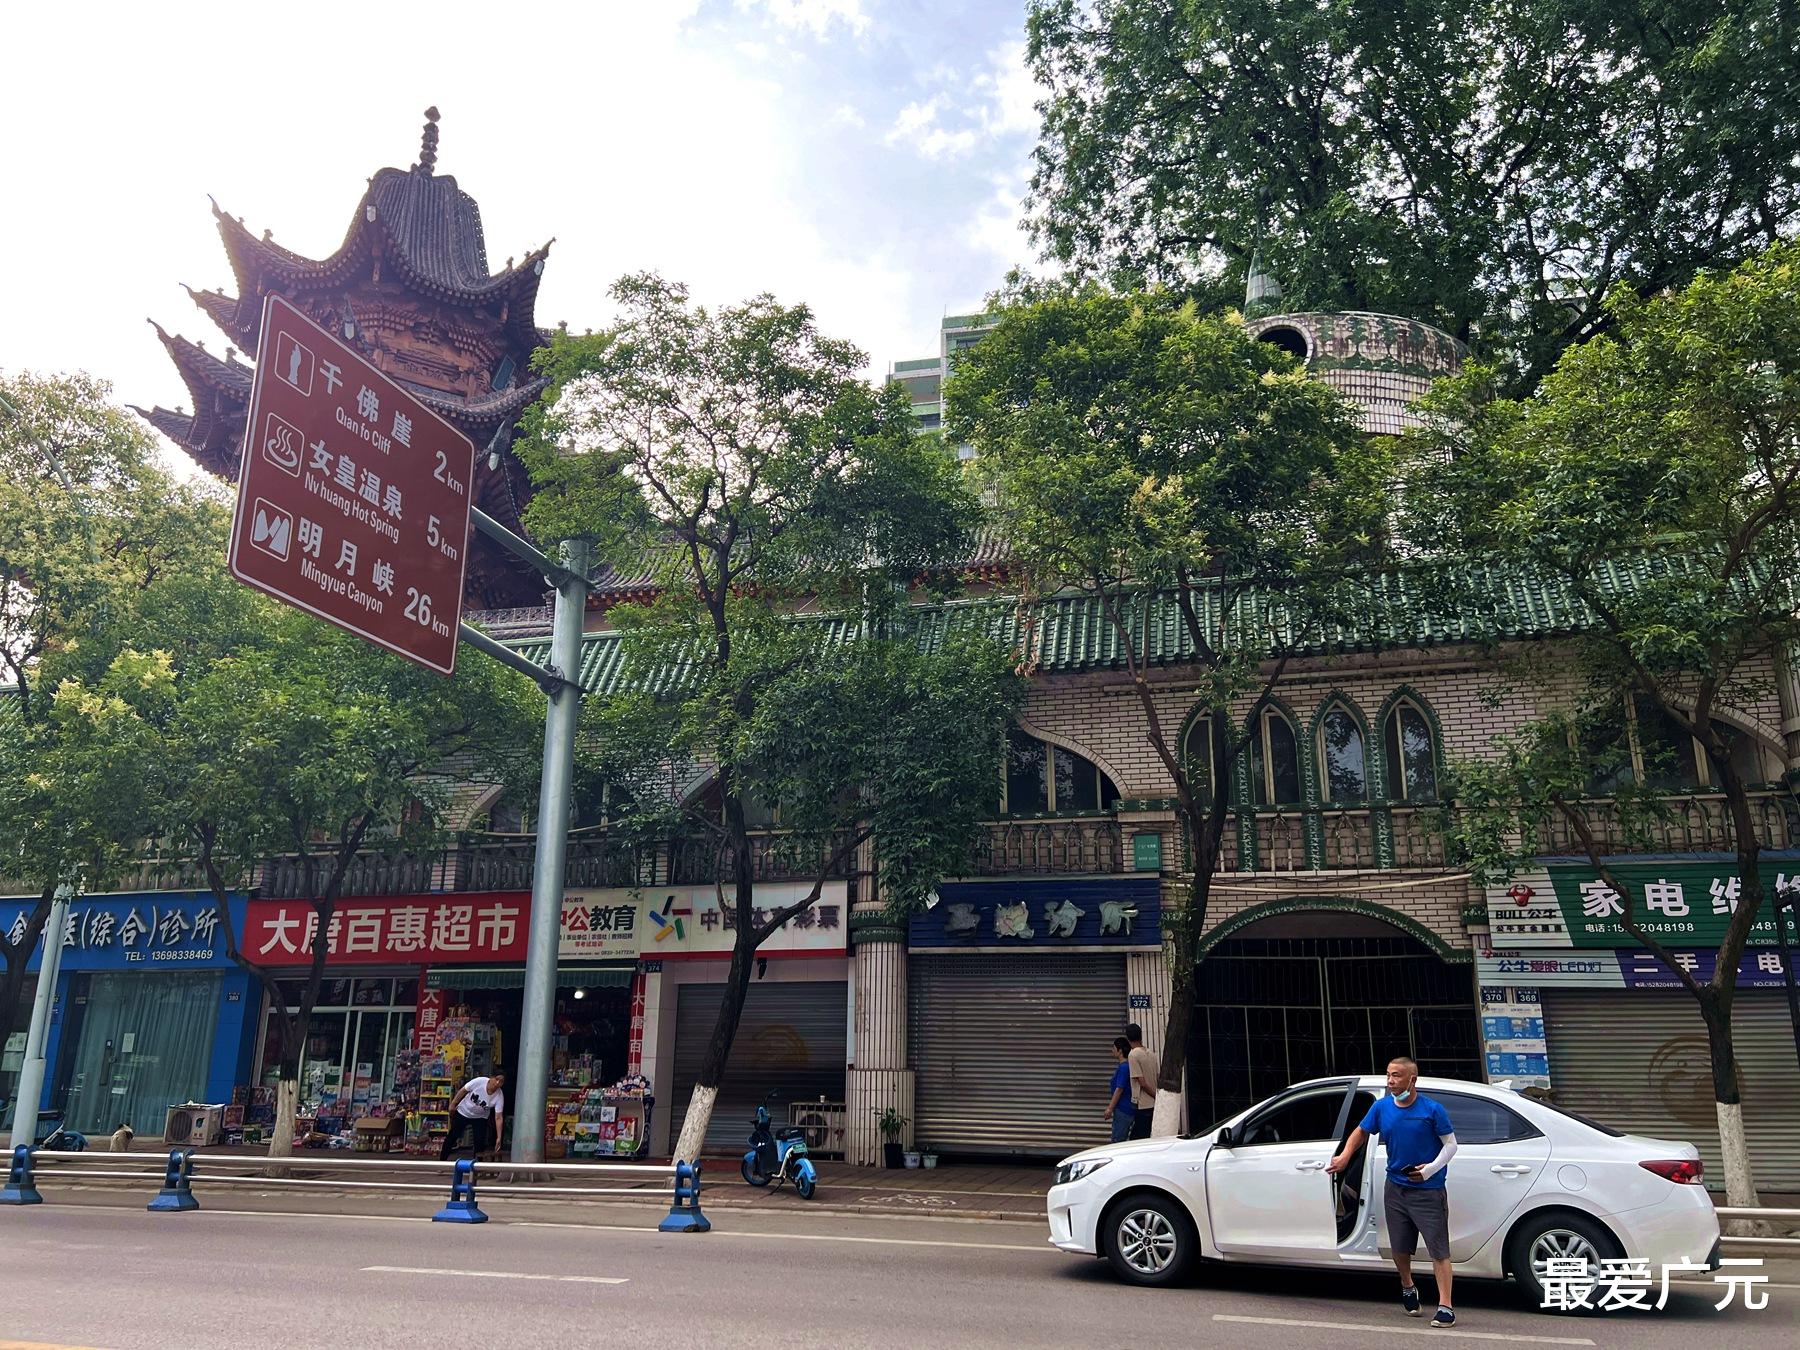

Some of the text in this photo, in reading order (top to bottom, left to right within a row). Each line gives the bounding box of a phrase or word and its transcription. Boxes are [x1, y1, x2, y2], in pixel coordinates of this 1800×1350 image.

[320, 359, 412, 448] 千佛崖
[336, 407, 391, 455] Qian fo Cliff
[309, 440, 402, 520] 女皇温泉
[433, 450, 463, 495] 2 km
[352, 500, 369, 524] Hot
[370, 511, 399, 544] Spring
[427, 515, 457, 560] 5 km
[298, 516, 394, 597] 明月峡
[301, 558, 383, 614] Mingyue Canyon
[404, 587, 449, 637] 26 km
[259, 903, 519, 955] 大唐百惠超市
[1496, 909, 1557, 919] BULL 公牛
[1585, 923, 1694, 932] 电话:152048198
[125, 950, 213, 961] TEL: 13698338469
